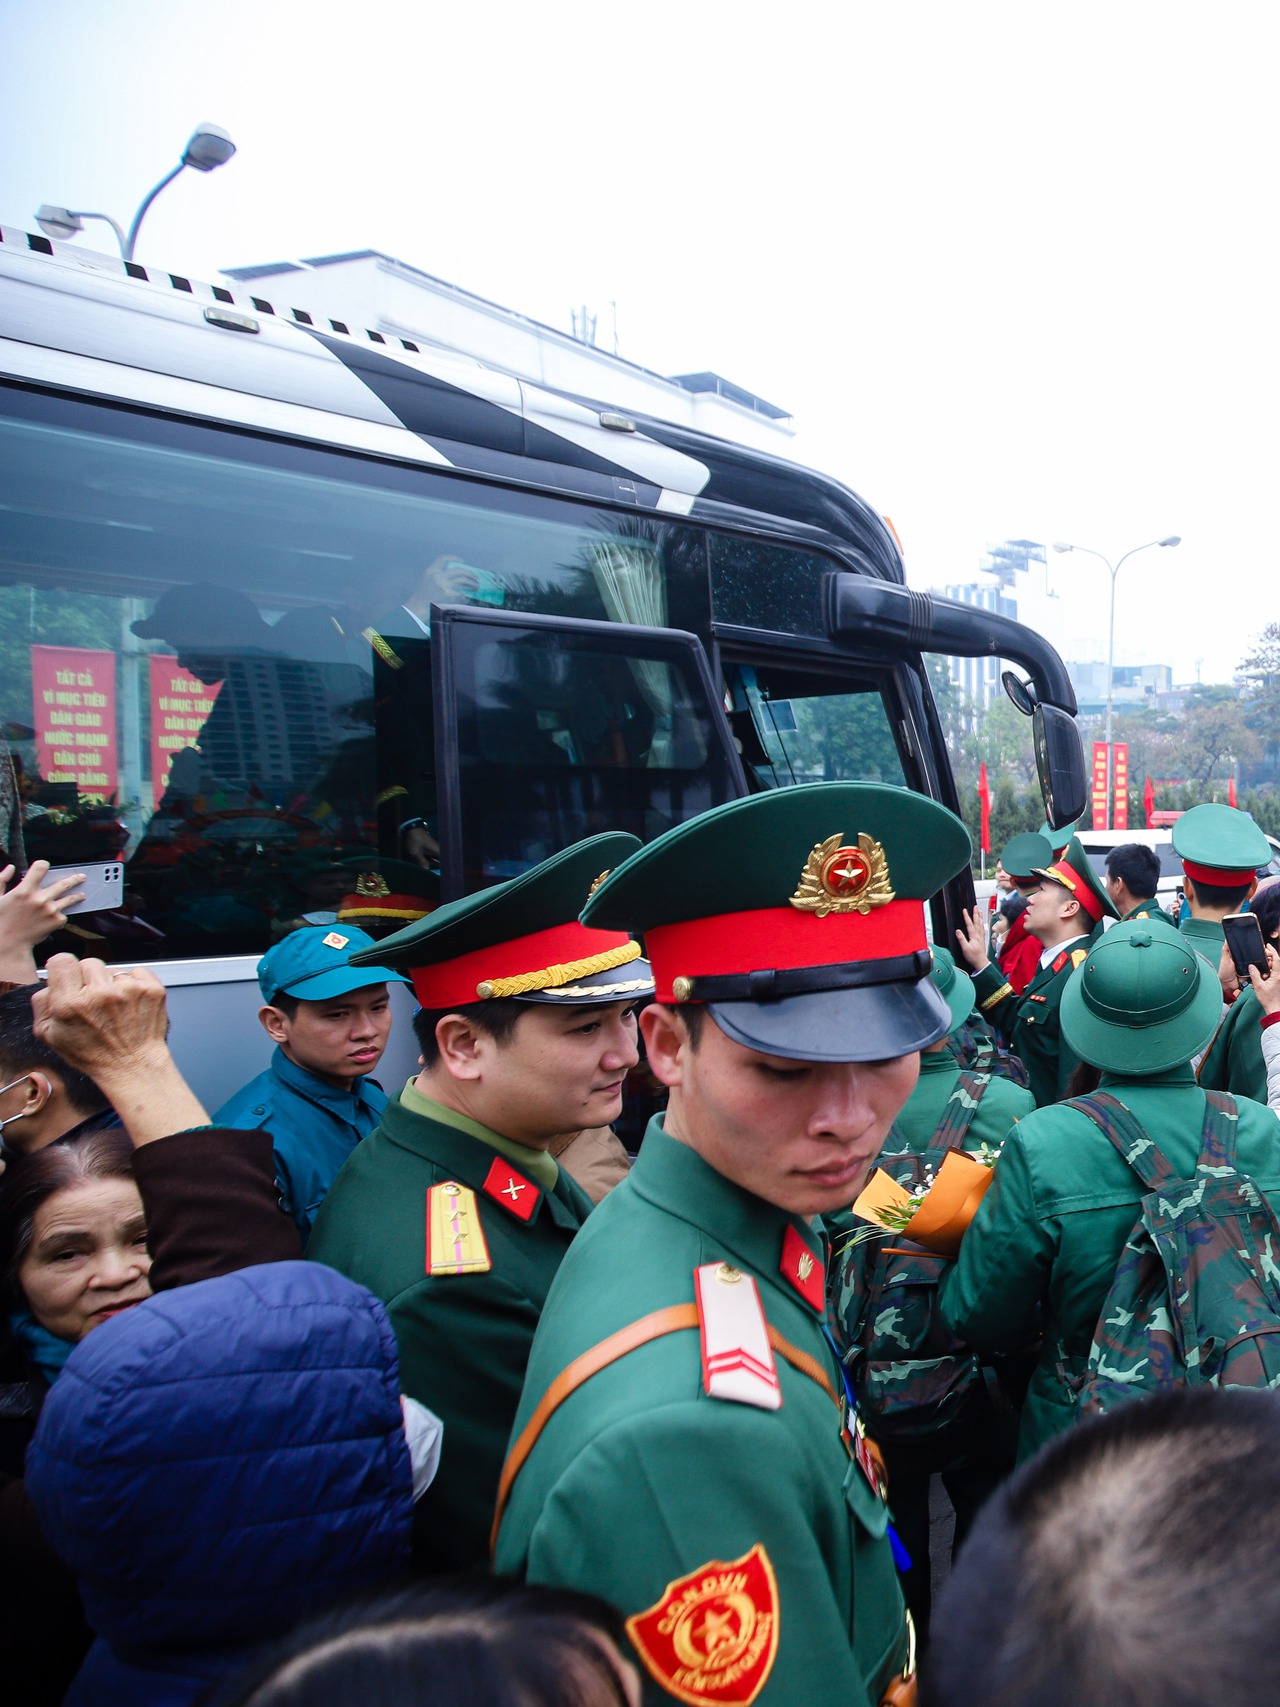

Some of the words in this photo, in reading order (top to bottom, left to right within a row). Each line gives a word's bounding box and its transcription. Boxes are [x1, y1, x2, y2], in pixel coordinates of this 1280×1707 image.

[56, 667, 76, 686] TẤT
[77, 667, 94, 687] CẢ
[170, 676, 188, 693] TẤT
[43, 688, 54, 704] VÌ
[56, 691, 82, 708] MỤC
[83, 691, 107, 708] TIÊU
[169, 698, 193, 714] MỤC
[50, 709, 73, 725] DÂN
[75, 710, 102, 727] GIÀU
[165, 715, 184, 730] DÂN
[44, 728, 74, 746] NƯỚC
[76, 732, 109, 749] MẠNH
[54, 749, 76, 766] DÂN
[78, 747, 102, 767] CHỦ
[78, 766, 109, 787] BẰNG
